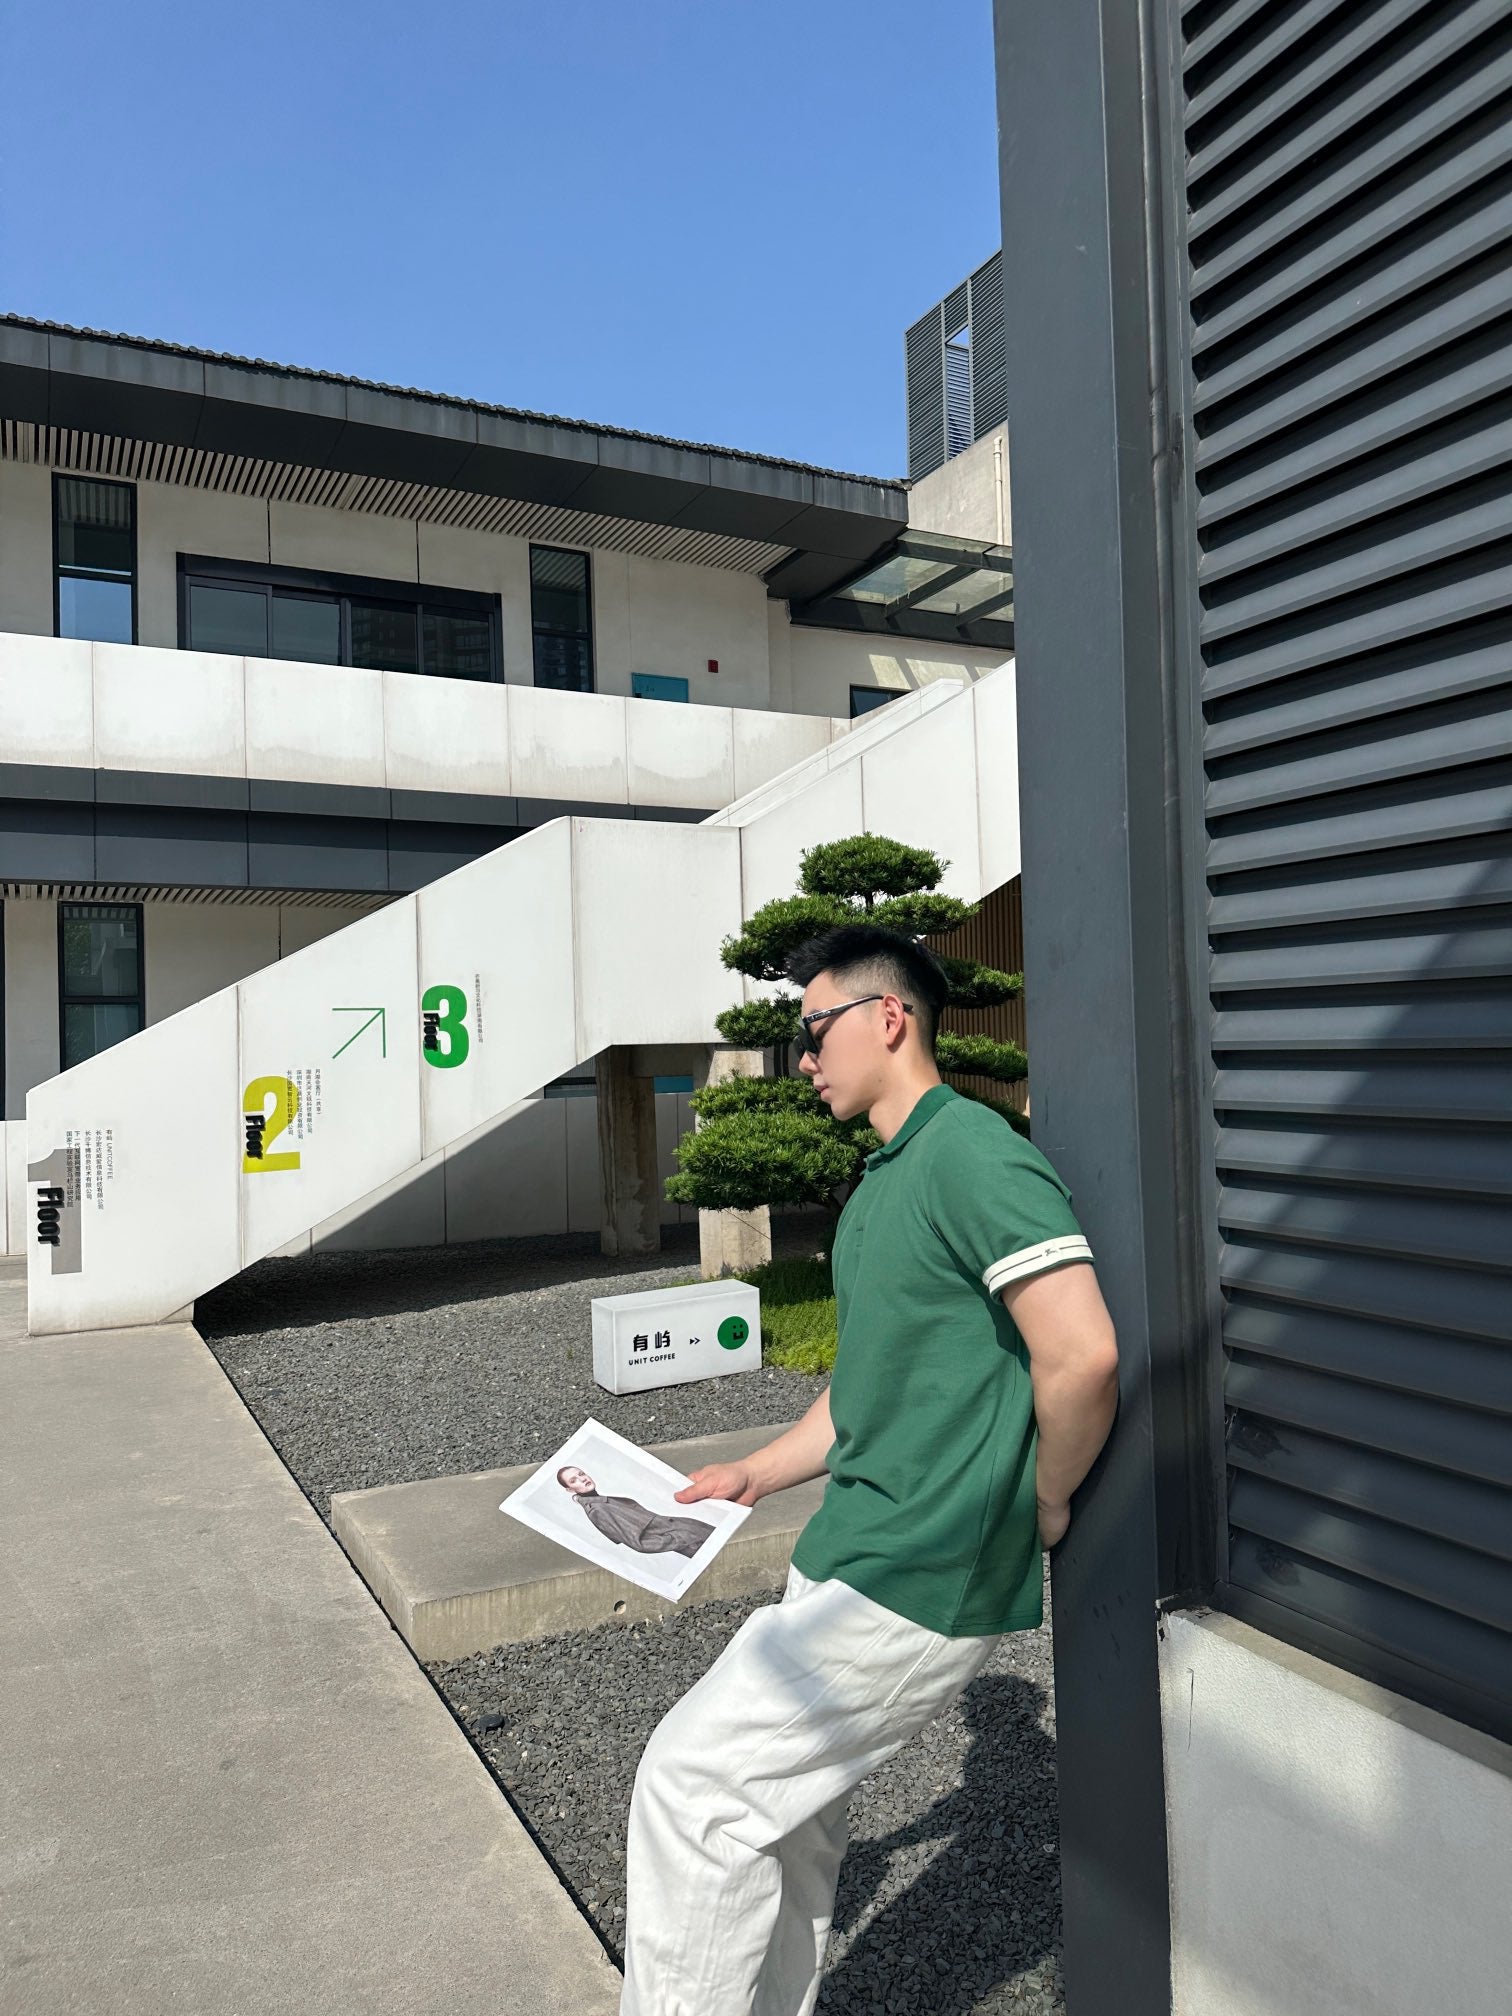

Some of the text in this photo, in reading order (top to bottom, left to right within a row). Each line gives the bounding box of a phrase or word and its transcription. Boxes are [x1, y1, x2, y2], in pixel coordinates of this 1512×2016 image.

[422, 985, 469, 1068] 3
[423, 1013, 441, 1052] Floor
[243, 1075, 300, 1174] 2
[245, 1114, 266, 1160] Floor
[28, 1148, 82, 1275] 1
[37, 1187, 65, 1247] Floor
[628, 1352, 676, 1366] UNIT COFFEE
[633, 1330, 671, 1352] 有屿
